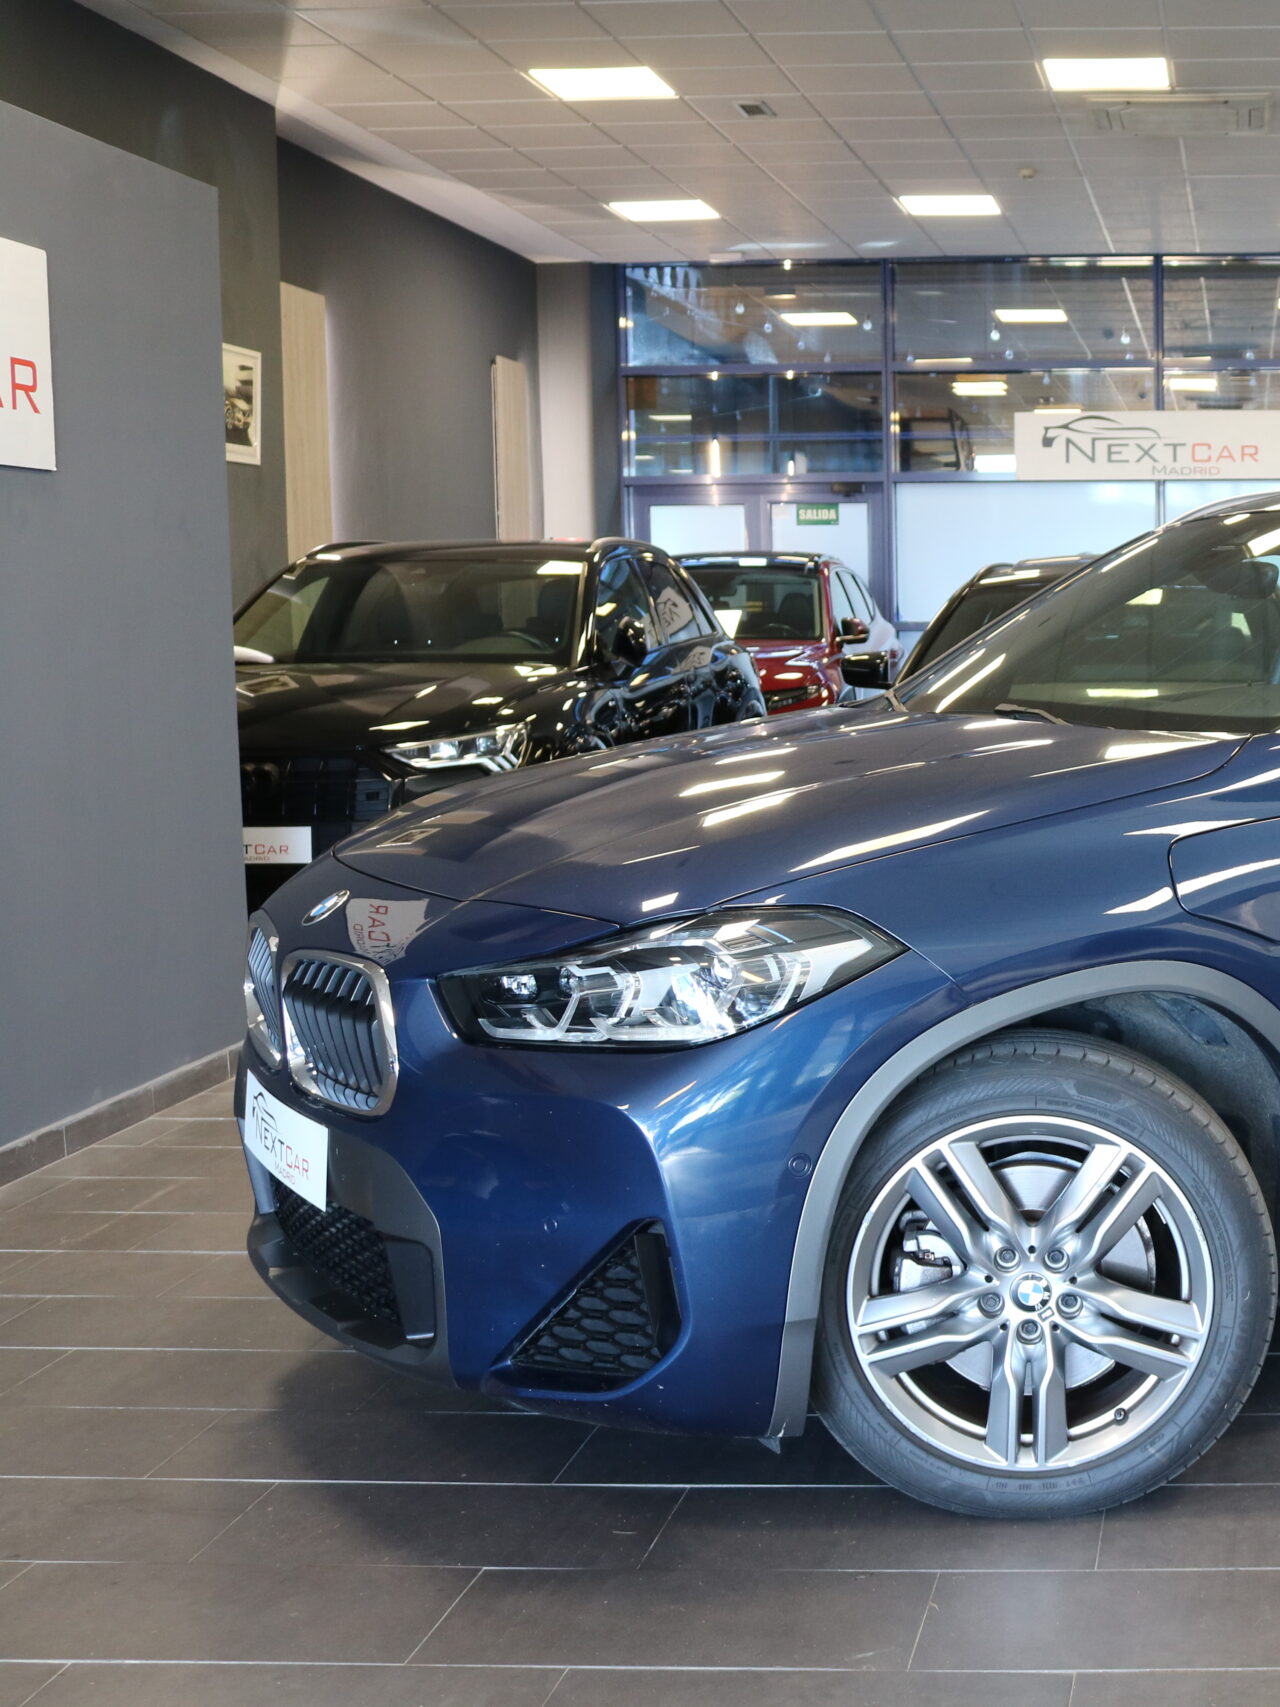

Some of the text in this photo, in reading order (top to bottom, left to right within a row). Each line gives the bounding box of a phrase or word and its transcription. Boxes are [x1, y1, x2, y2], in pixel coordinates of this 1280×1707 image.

[1065, 437, 1259, 463] NEXTCAR
[1152, 465, 1221, 476] MADRID
[799, 509, 837, 520] SALIDA
[255, 1112, 310, 1181] NEXTCAR
[274, 1160, 297, 1185] MADRID
